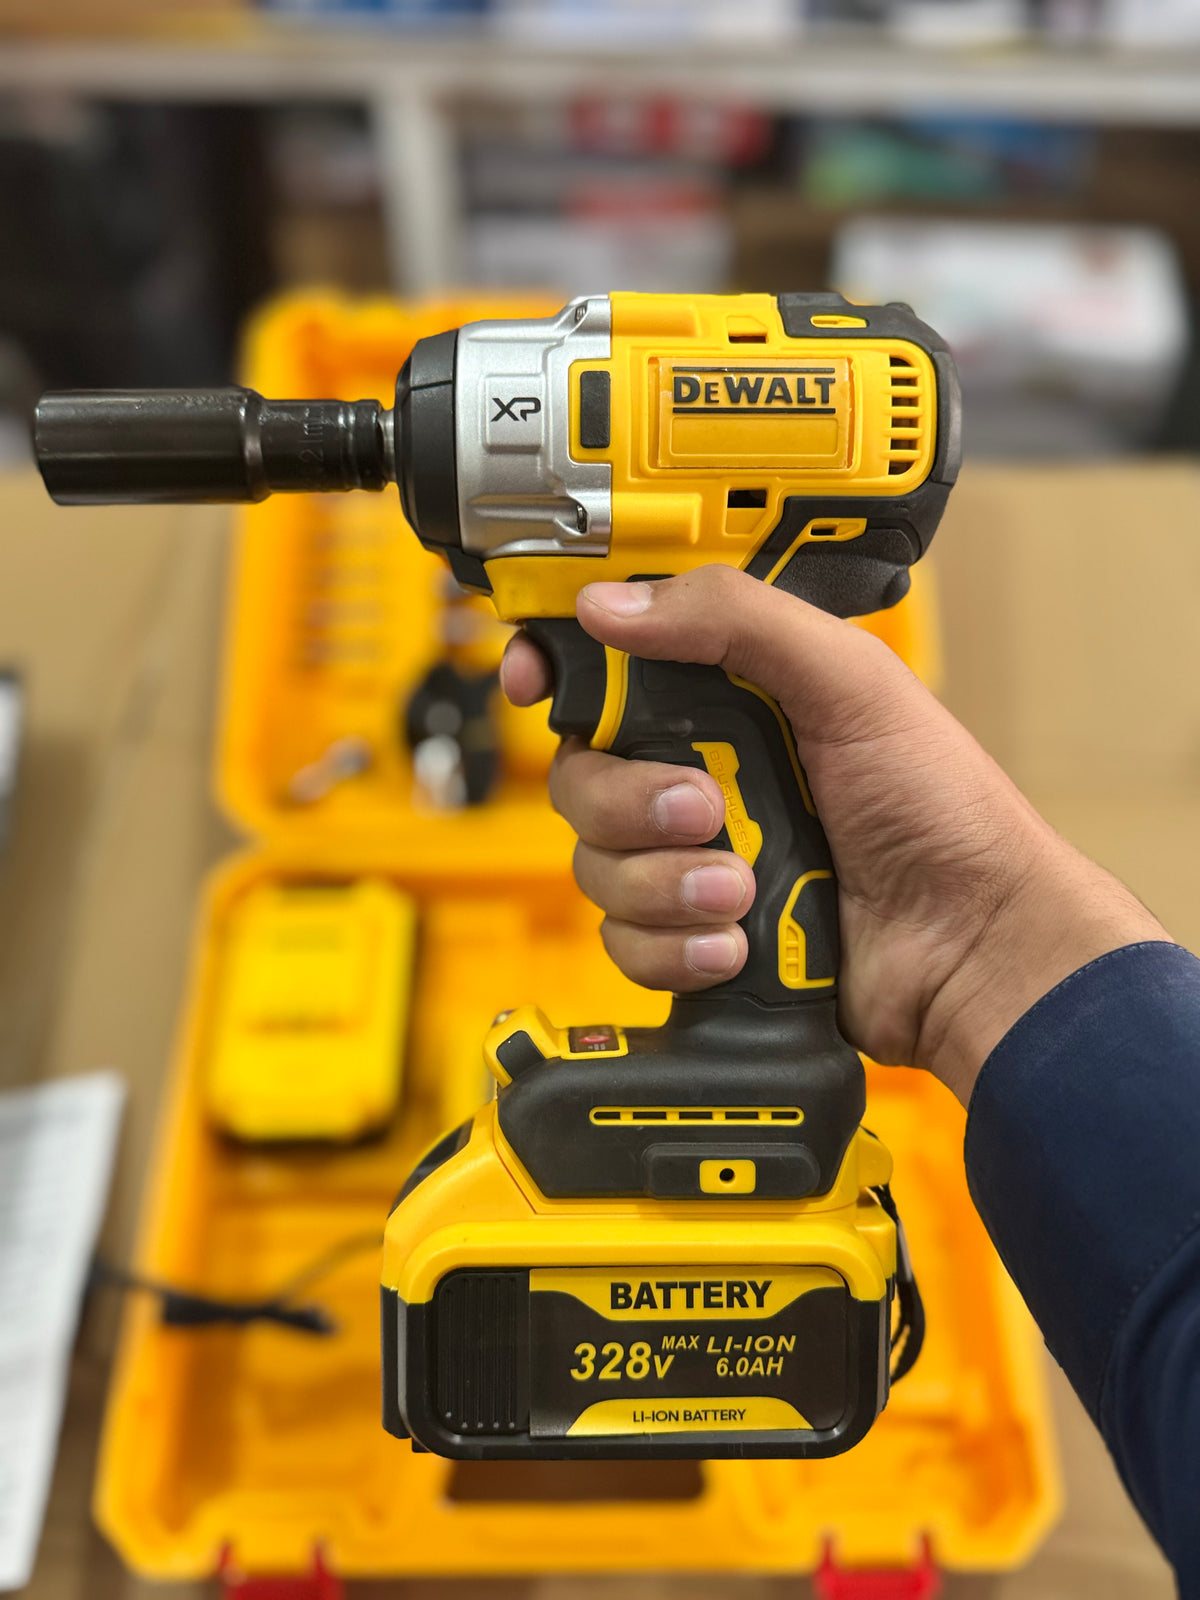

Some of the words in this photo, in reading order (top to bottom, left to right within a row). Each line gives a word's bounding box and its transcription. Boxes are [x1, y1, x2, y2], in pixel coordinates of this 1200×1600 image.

[490, 396, 542, 422] XP
[709, 750, 752, 855] BRUSHLESS
[610, 1280, 773, 1310] BATTERY
[662, 1335, 700, 1350] MAX
[706, 1335, 797, 1353] LI-ION
[716, 1356, 784, 1377] 6.0AH
[633, 1410, 680, 1423] LI-ION
[683, 1408, 747, 1422] BATTERY
